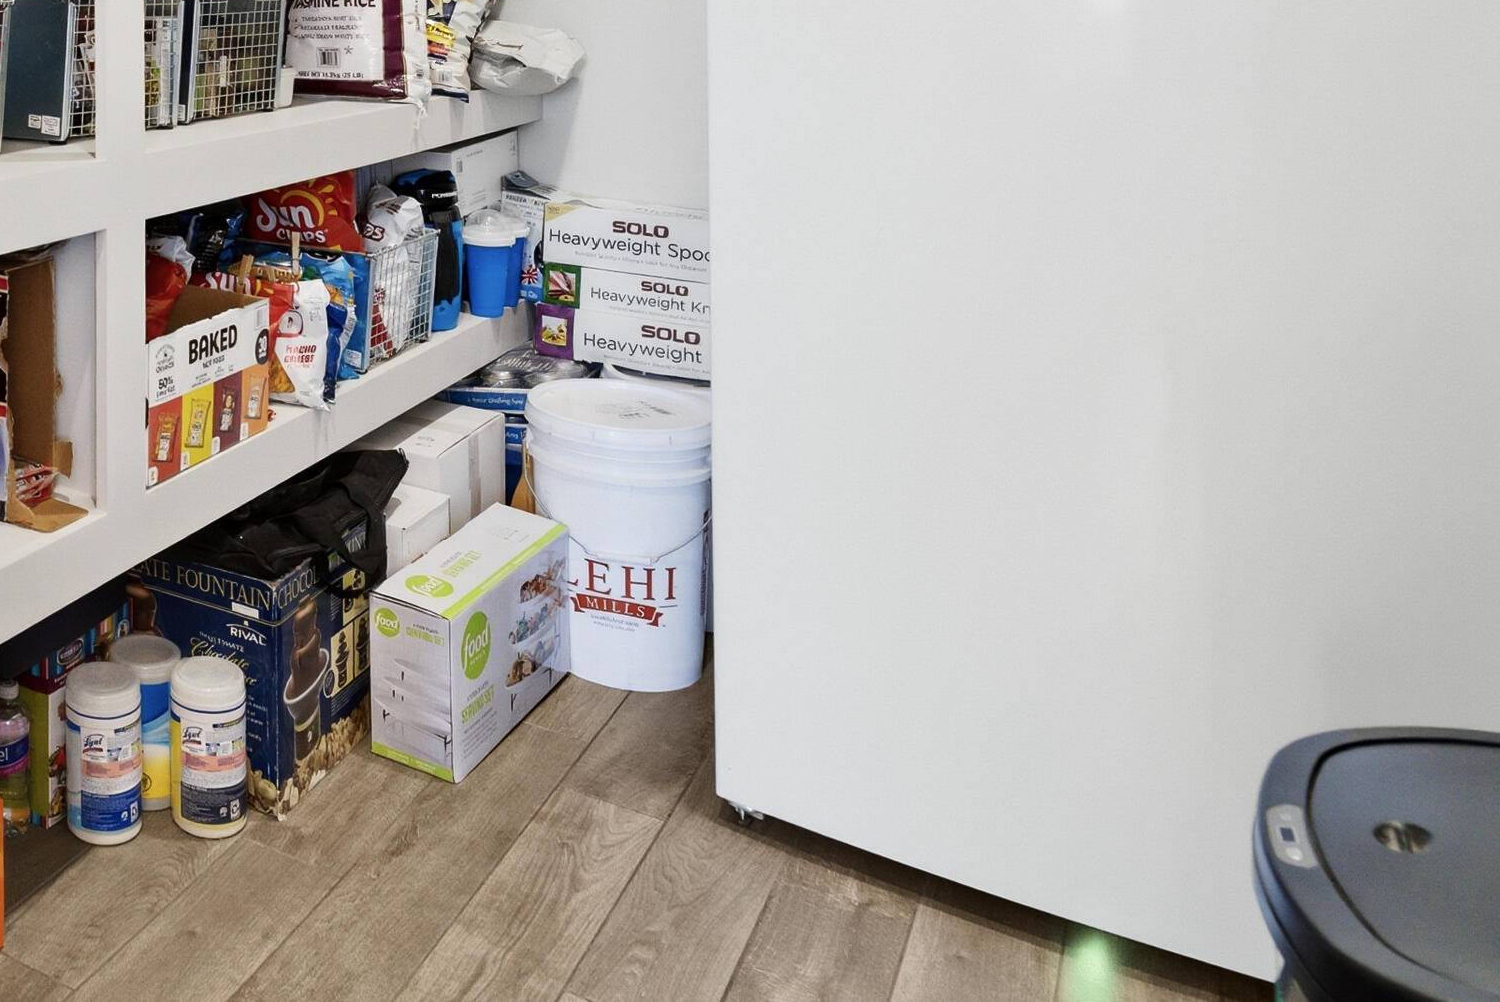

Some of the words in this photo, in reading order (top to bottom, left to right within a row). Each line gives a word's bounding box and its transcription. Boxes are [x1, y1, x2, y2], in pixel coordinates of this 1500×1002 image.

[255, 197, 316, 234] Sun
[612, 219, 670, 240] SOLO
[549, 228, 662, 257] Heavyweight
[641, 280, 689, 297] SOLO
[590, 287, 686, 313] Heavyweight
[188, 324, 238, 365] BAKED
[641, 324, 700, 346] SOLO
[583, 332, 703, 365] Heavyweight
[175, 564, 271, 612] FOUNTAIN
[585, 596, 646, 618] MILLS
[375, 613, 400, 631] food
[230, 626, 267, 647] RIVAL
[463, 620, 492, 672] food
[83, 735, 104, 749] Lysol
[183, 727, 202, 740] Lysol
